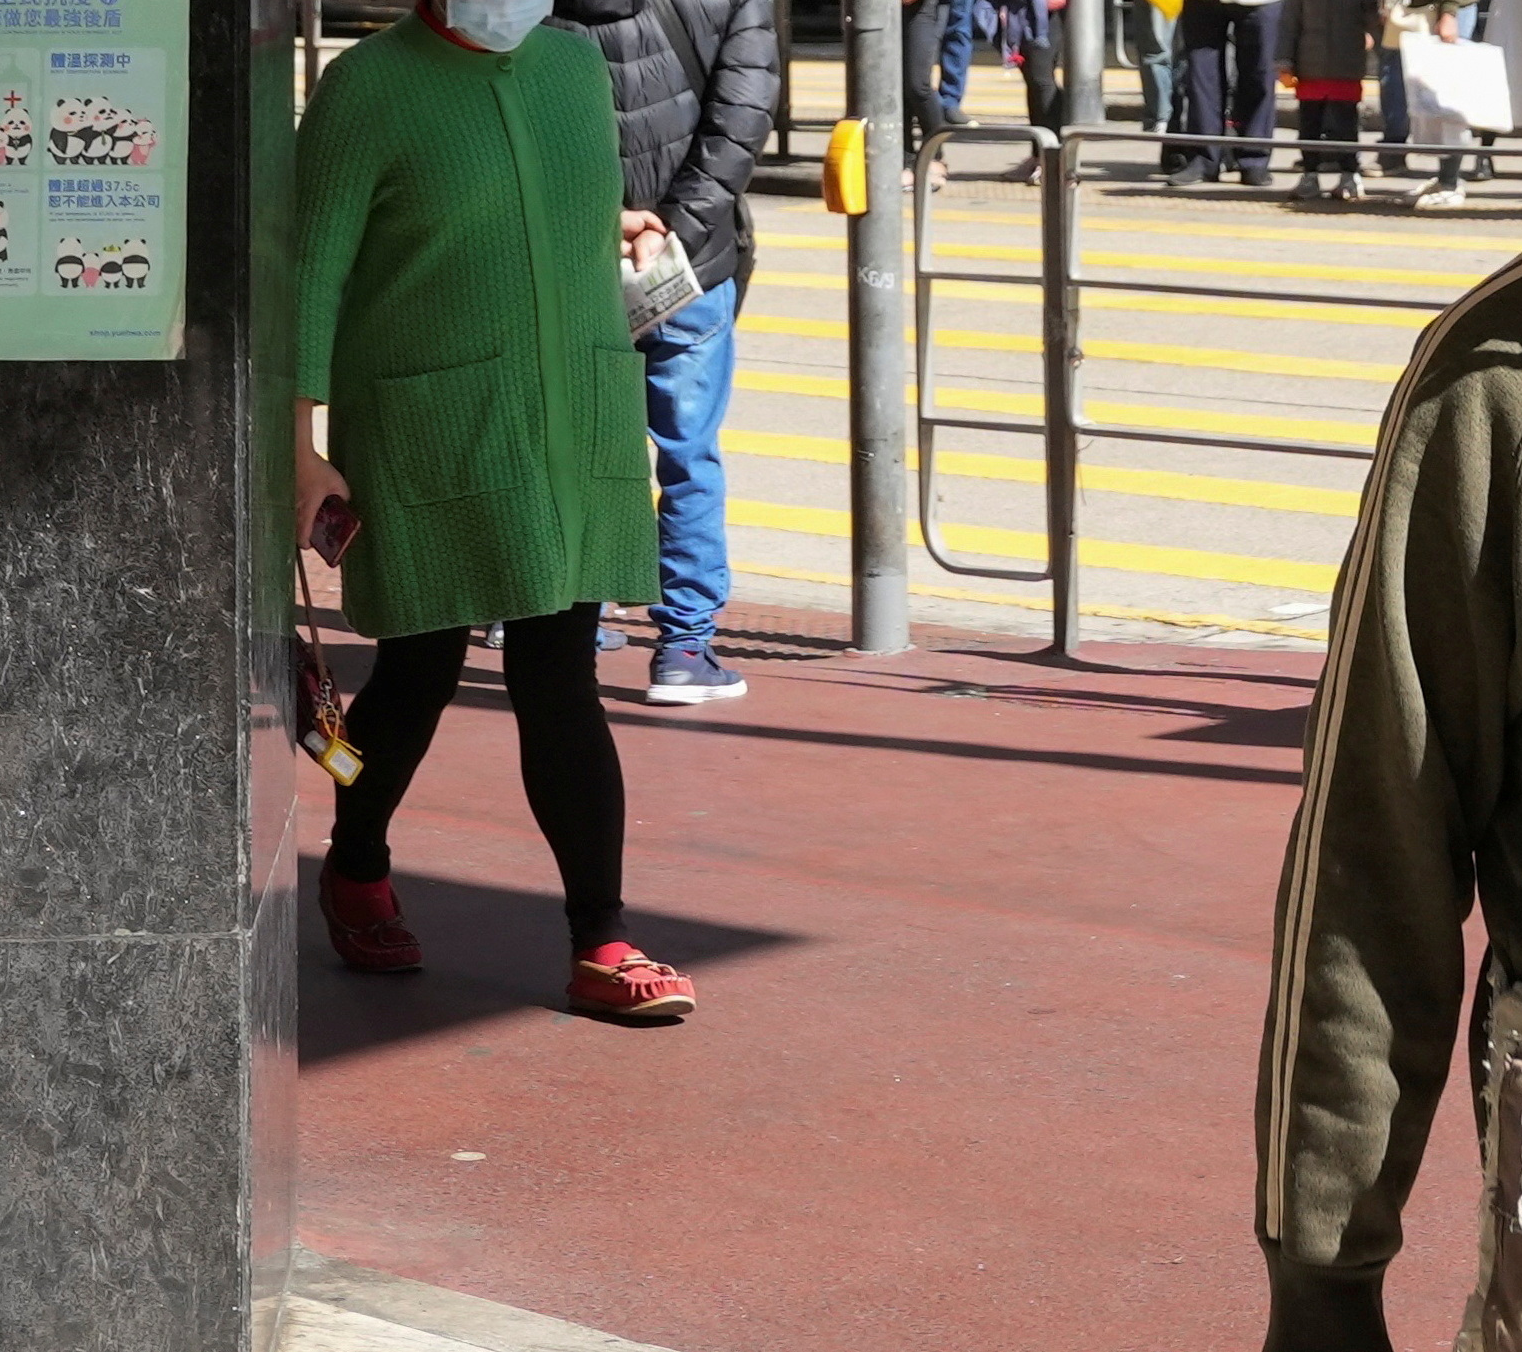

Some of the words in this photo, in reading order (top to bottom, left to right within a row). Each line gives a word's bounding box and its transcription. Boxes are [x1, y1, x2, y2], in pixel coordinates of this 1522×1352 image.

[50, 52, 131, 69] 體溫探測中
